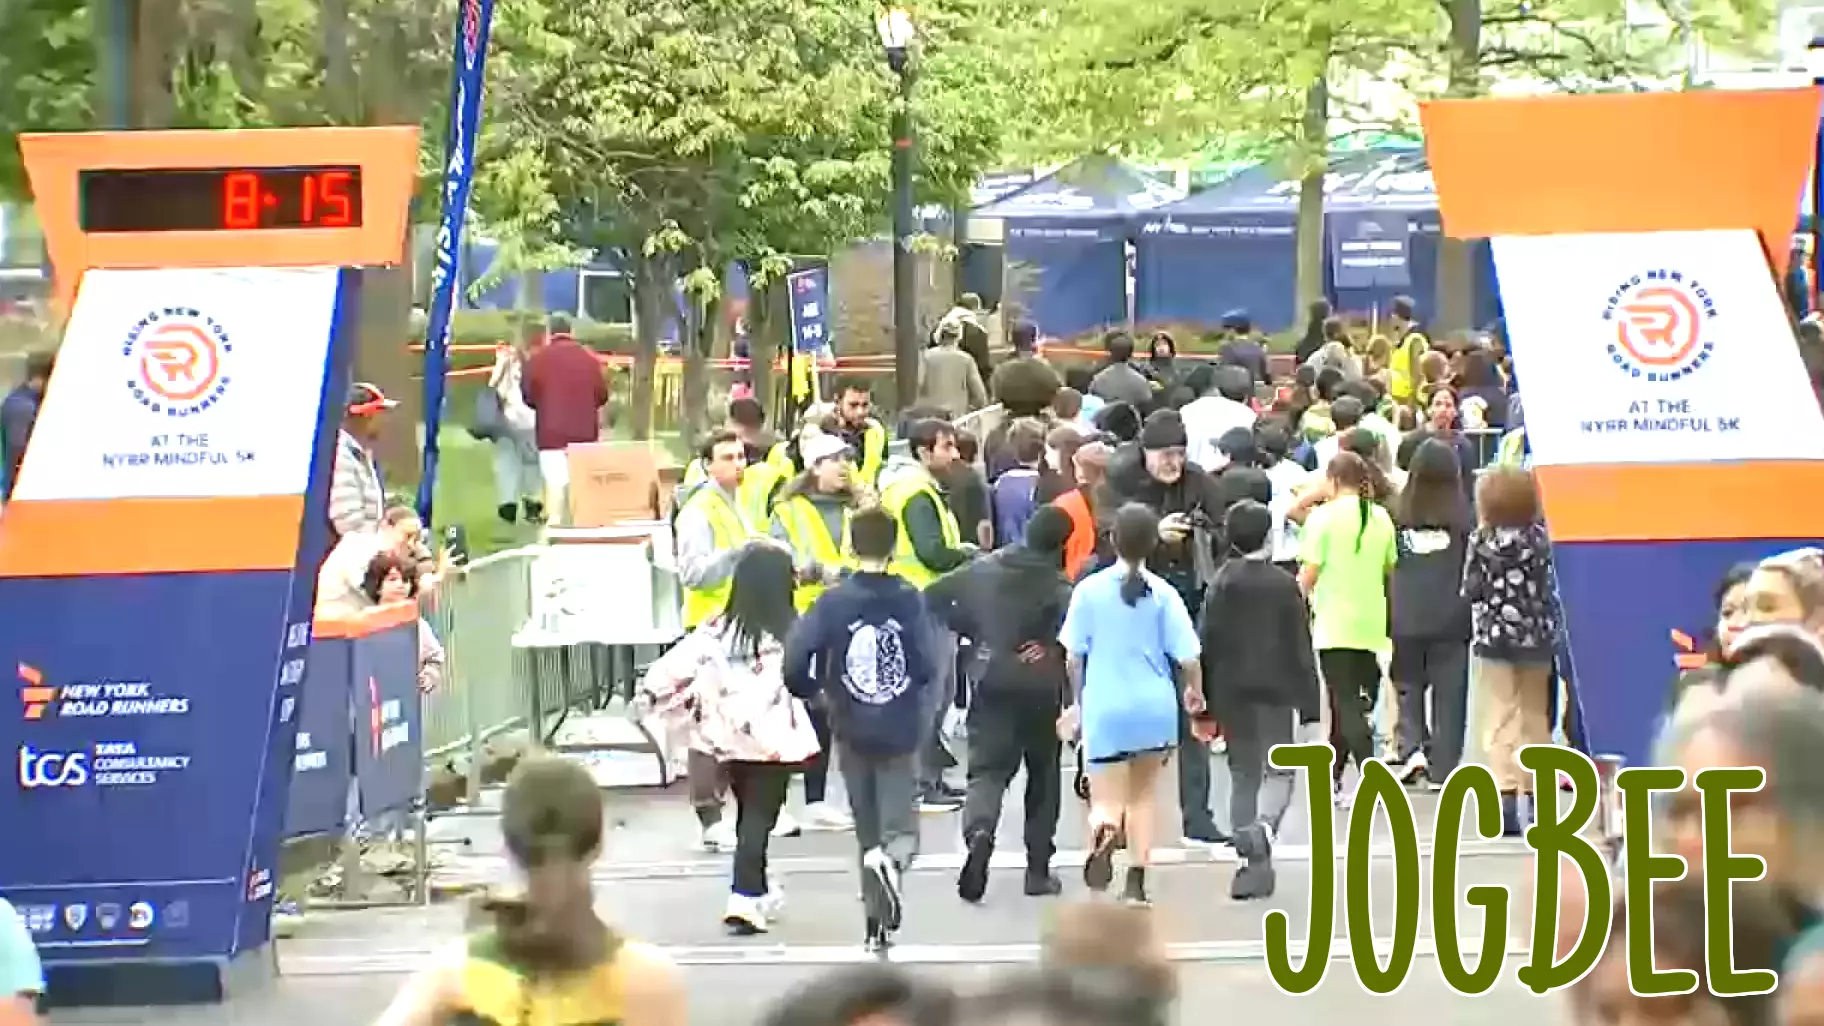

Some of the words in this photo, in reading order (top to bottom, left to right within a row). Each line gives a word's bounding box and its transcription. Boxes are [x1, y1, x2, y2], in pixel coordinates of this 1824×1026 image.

[1647, 268, 1684, 284] NEW
[1690, 279, 1719, 320] YORK
[163, 306, 200, 318] NEW
[206, 316, 233, 353] YORK
[1606, 343, 1642, 378] ROAD
[126, 379, 161, 413] ROAD
[1628, 400, 1649, 414] AT
[1657, 398, 1692, 414] THE
[1633, 416, 1713, 433] MINDFUL
[1717, 415, 1741, 432] 5K
[151, 434, 170, 447] AT
[176, 433, 209, 448] THE
[153, 451, 229, 467] MINDFUL
[60, 684, 102, 700] NEW
[103, 682, 152, 699] YORK
[59, 700, 109, 717] ROAD
[110, 698, 191, 716] RUNNERS
[95, 742, 137, 755] TATA
[19, 744, 89, 787] tcs
[95, 756, 192, 771] CONSULTANCY
[95, 771, 158, 786] SERVICES
